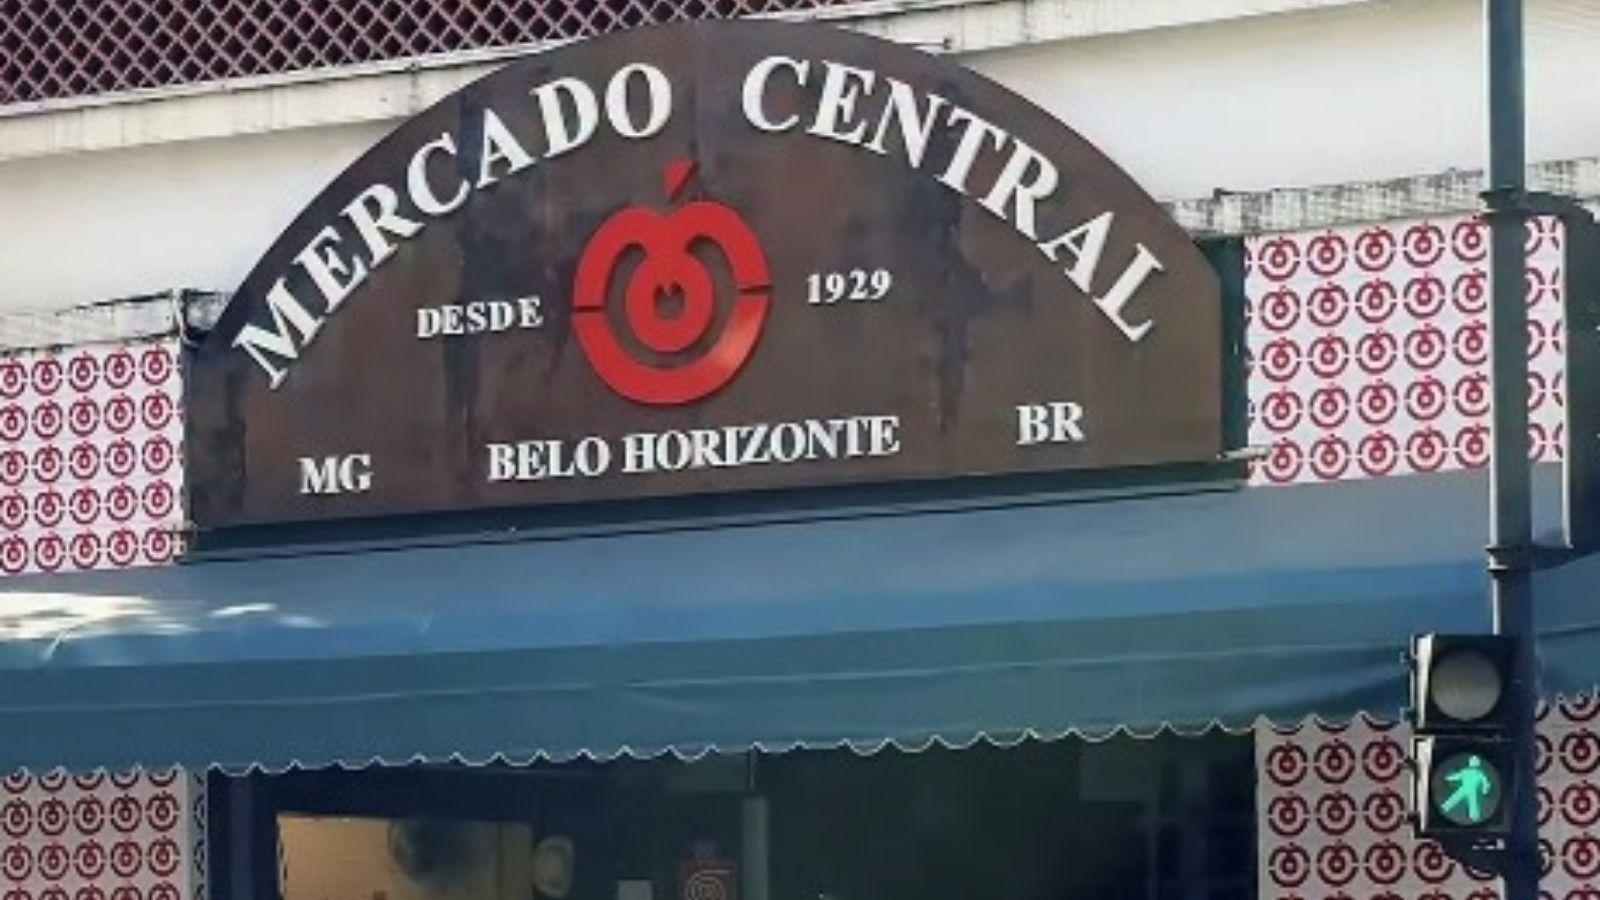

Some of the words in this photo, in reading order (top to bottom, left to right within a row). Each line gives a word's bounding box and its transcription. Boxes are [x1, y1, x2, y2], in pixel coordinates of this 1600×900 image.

[232, 62, 672, 390] MERCADO
[742, 55, 1164, 342] CENTRAL
[416, 296, 543, 339] DESDE
[806, 269, 892, 305] 1929
[487, 437, 610, 482] BELO
[622, 415, 901, 474] HORIZONTE
[1016, 402, 1085, 446] BR
[299, 453, 373, 495] MG
